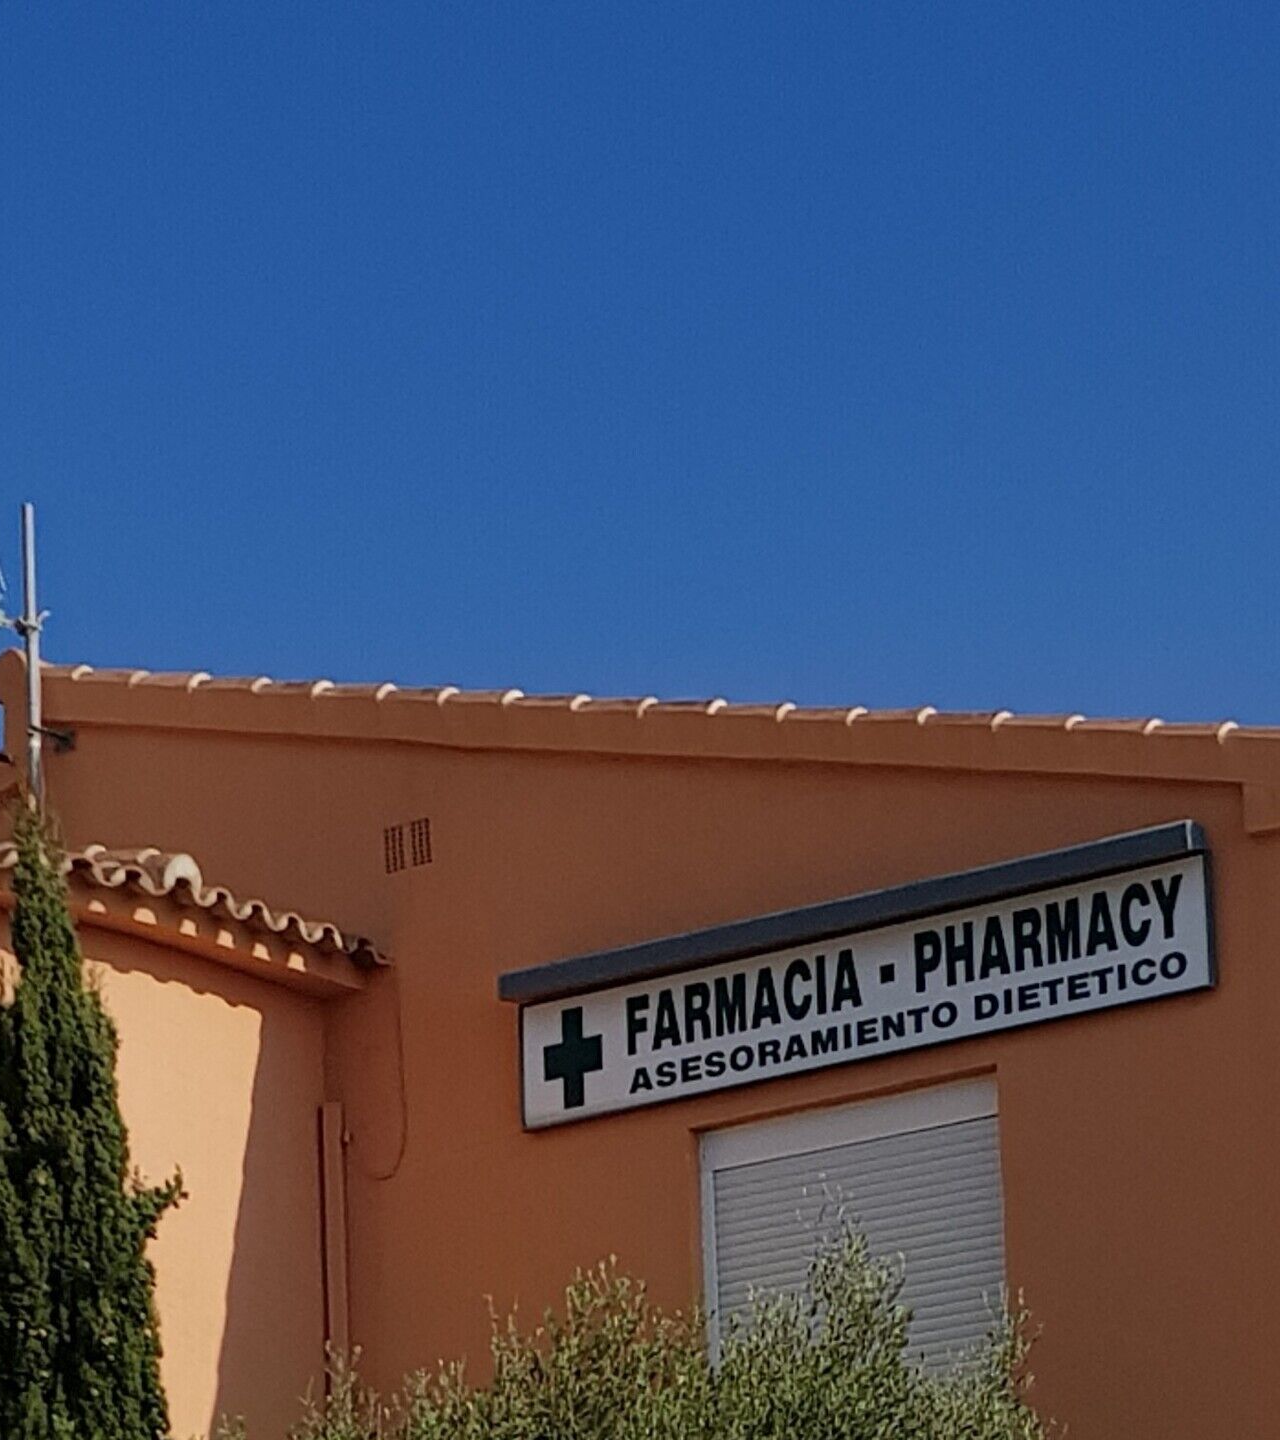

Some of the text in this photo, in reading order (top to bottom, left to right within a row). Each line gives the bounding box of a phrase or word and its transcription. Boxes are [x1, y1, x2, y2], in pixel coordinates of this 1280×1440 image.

[625, 871, 1184, 1057] FARMACIA PHARMACY
[629, 951, 1188, 1095] ASESORAMIENTO DIETETICO
